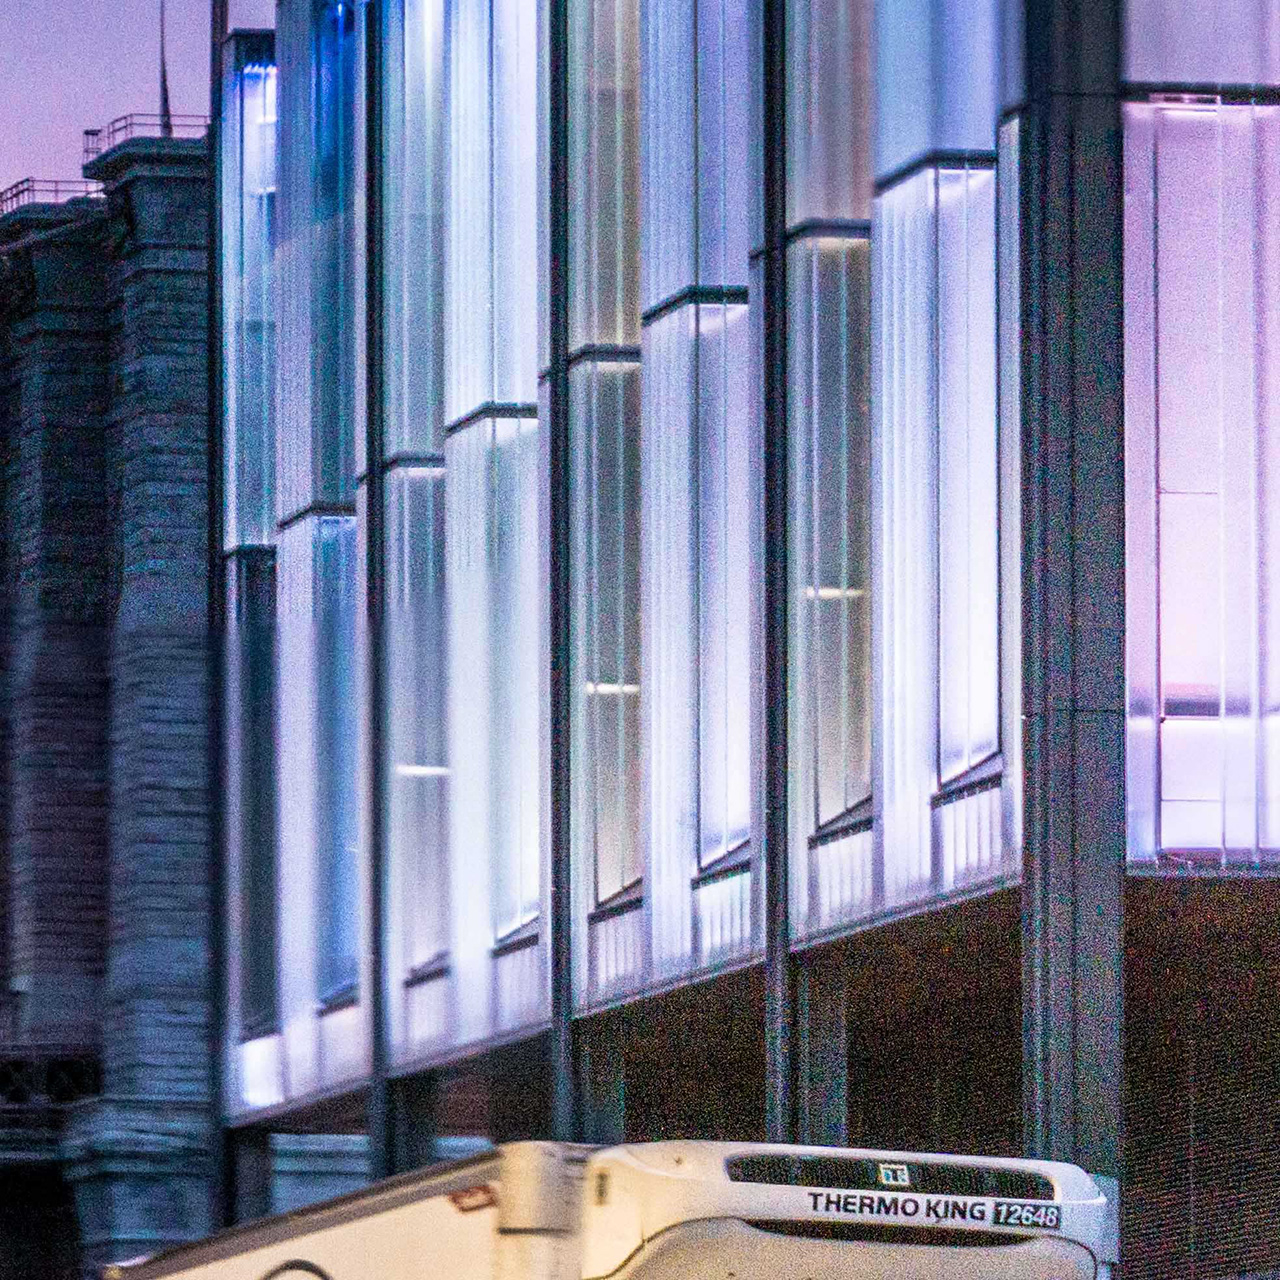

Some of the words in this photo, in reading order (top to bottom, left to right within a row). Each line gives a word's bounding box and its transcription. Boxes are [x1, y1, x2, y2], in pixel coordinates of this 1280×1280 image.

[808, 1192, 920, 1217] THERMO
[924, 1198, 987, 1222] KING
[997, 1203, 1058, 1227] 12648
